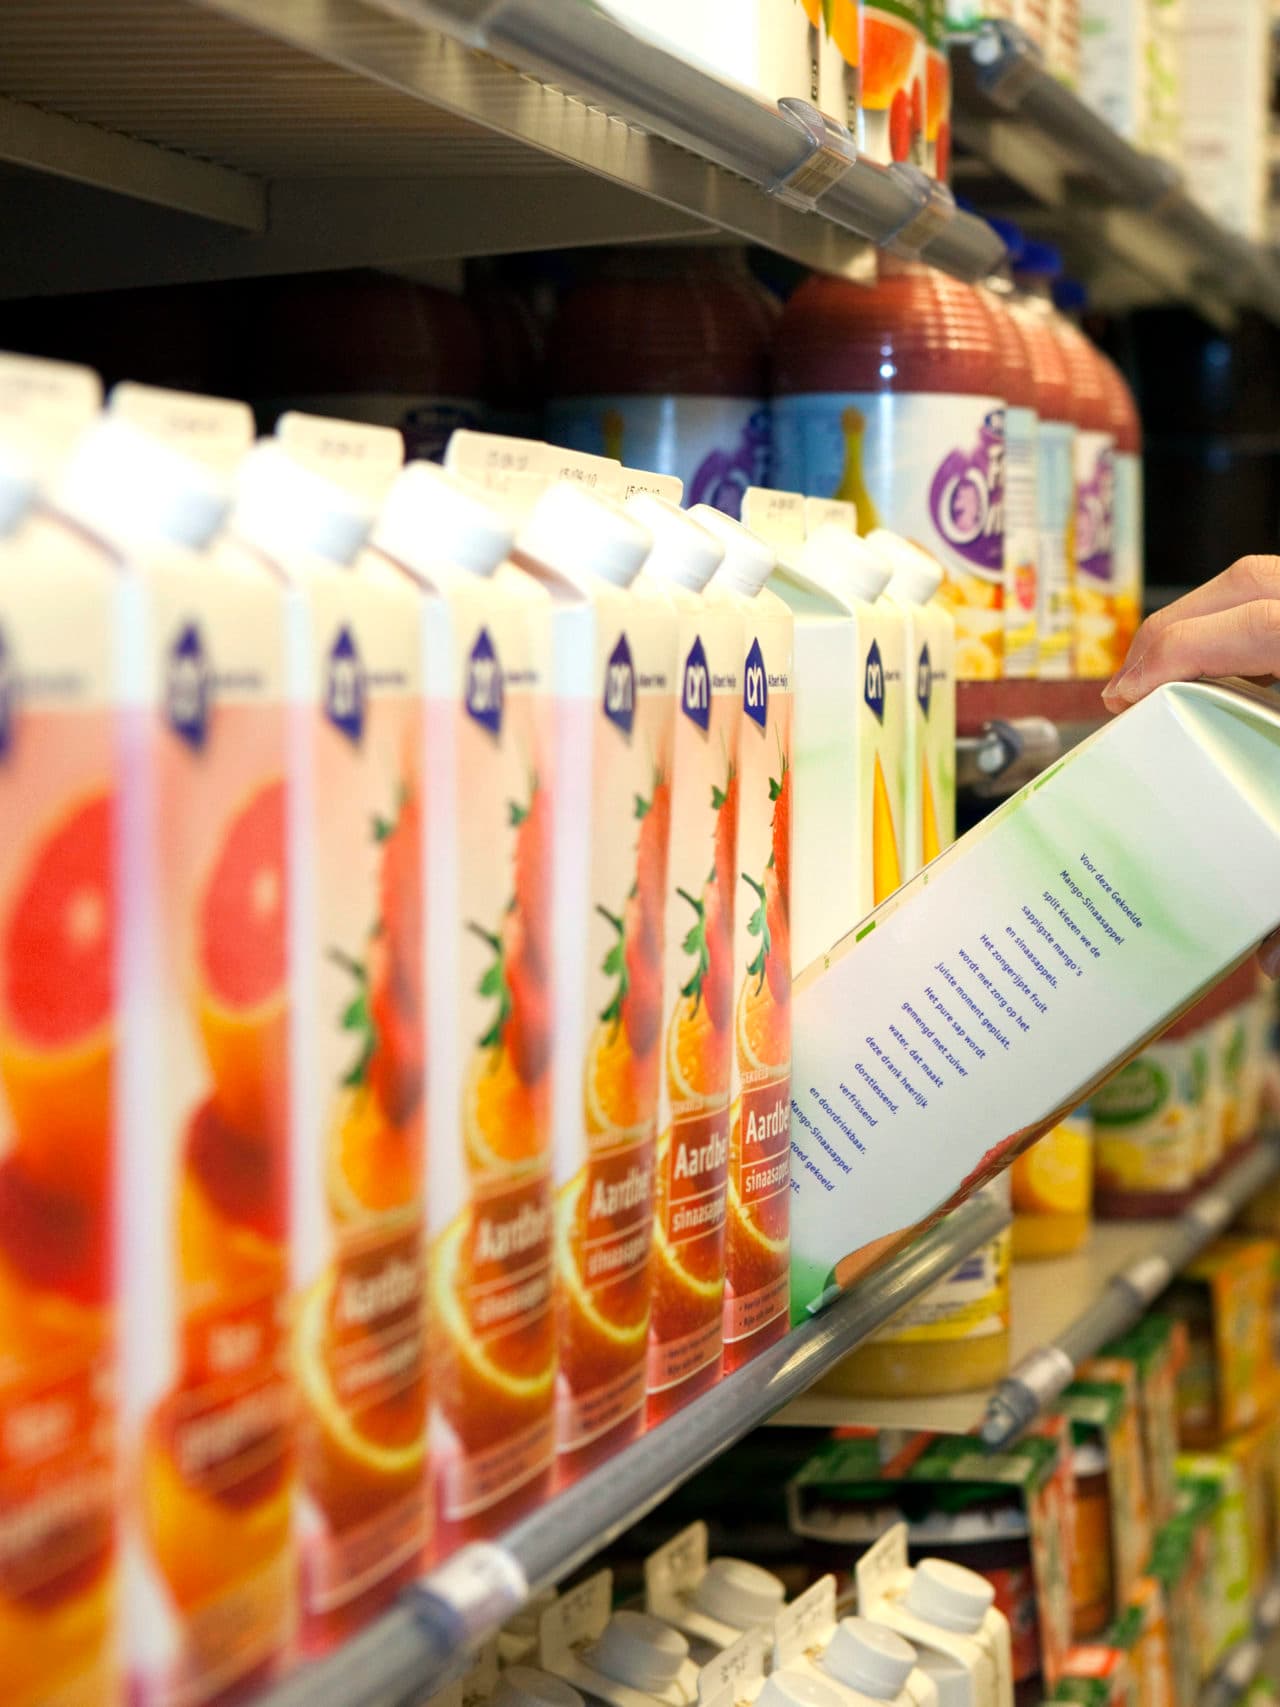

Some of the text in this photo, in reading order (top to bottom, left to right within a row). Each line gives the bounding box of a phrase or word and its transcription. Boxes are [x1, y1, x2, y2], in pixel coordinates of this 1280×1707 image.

[1042, 891, 1100, 958] split kiezen we de
[1059, 869, 1125, 945] Mango-Sinaasappel
[1079, 852, 1142, 928] Voor deze Gekoelde
[979, 933, 1047, 1013] Het zongerijpte fruit
[1004, 926, 1057, 989] en sinaasappels.
[1020, 905, 1083, 976] sappigste mango's
[923, 986, 986, 1059] Het pure sap wordt
[933, 961, 1009, 1050] juiste moment geplukt.
[958, 948, 1030, 1032] wordt met zorg op het
[865, 1036, 927, 1108] deze drank heerlijk
[888, 1024, 943, 1088] water, dat maakt
[900, 1002, 968, 1076] gemengd met zuiver
[745, 1099, 790, 1145] Aardbe
[809, 1087, 866, 1154] en doordrinkbaar.
[839, 1082, 878, 1127] verfrissend
[854, 1063, 899, 1114] dorstlessend,
[673, 1132, 728, 1179] Aardbe
[789, 1099, 852, 1174] Mango-Sinaasappel
[789, 1177, 800, 1193] st.
[804, 1160, 835, 1191] gekoeld
